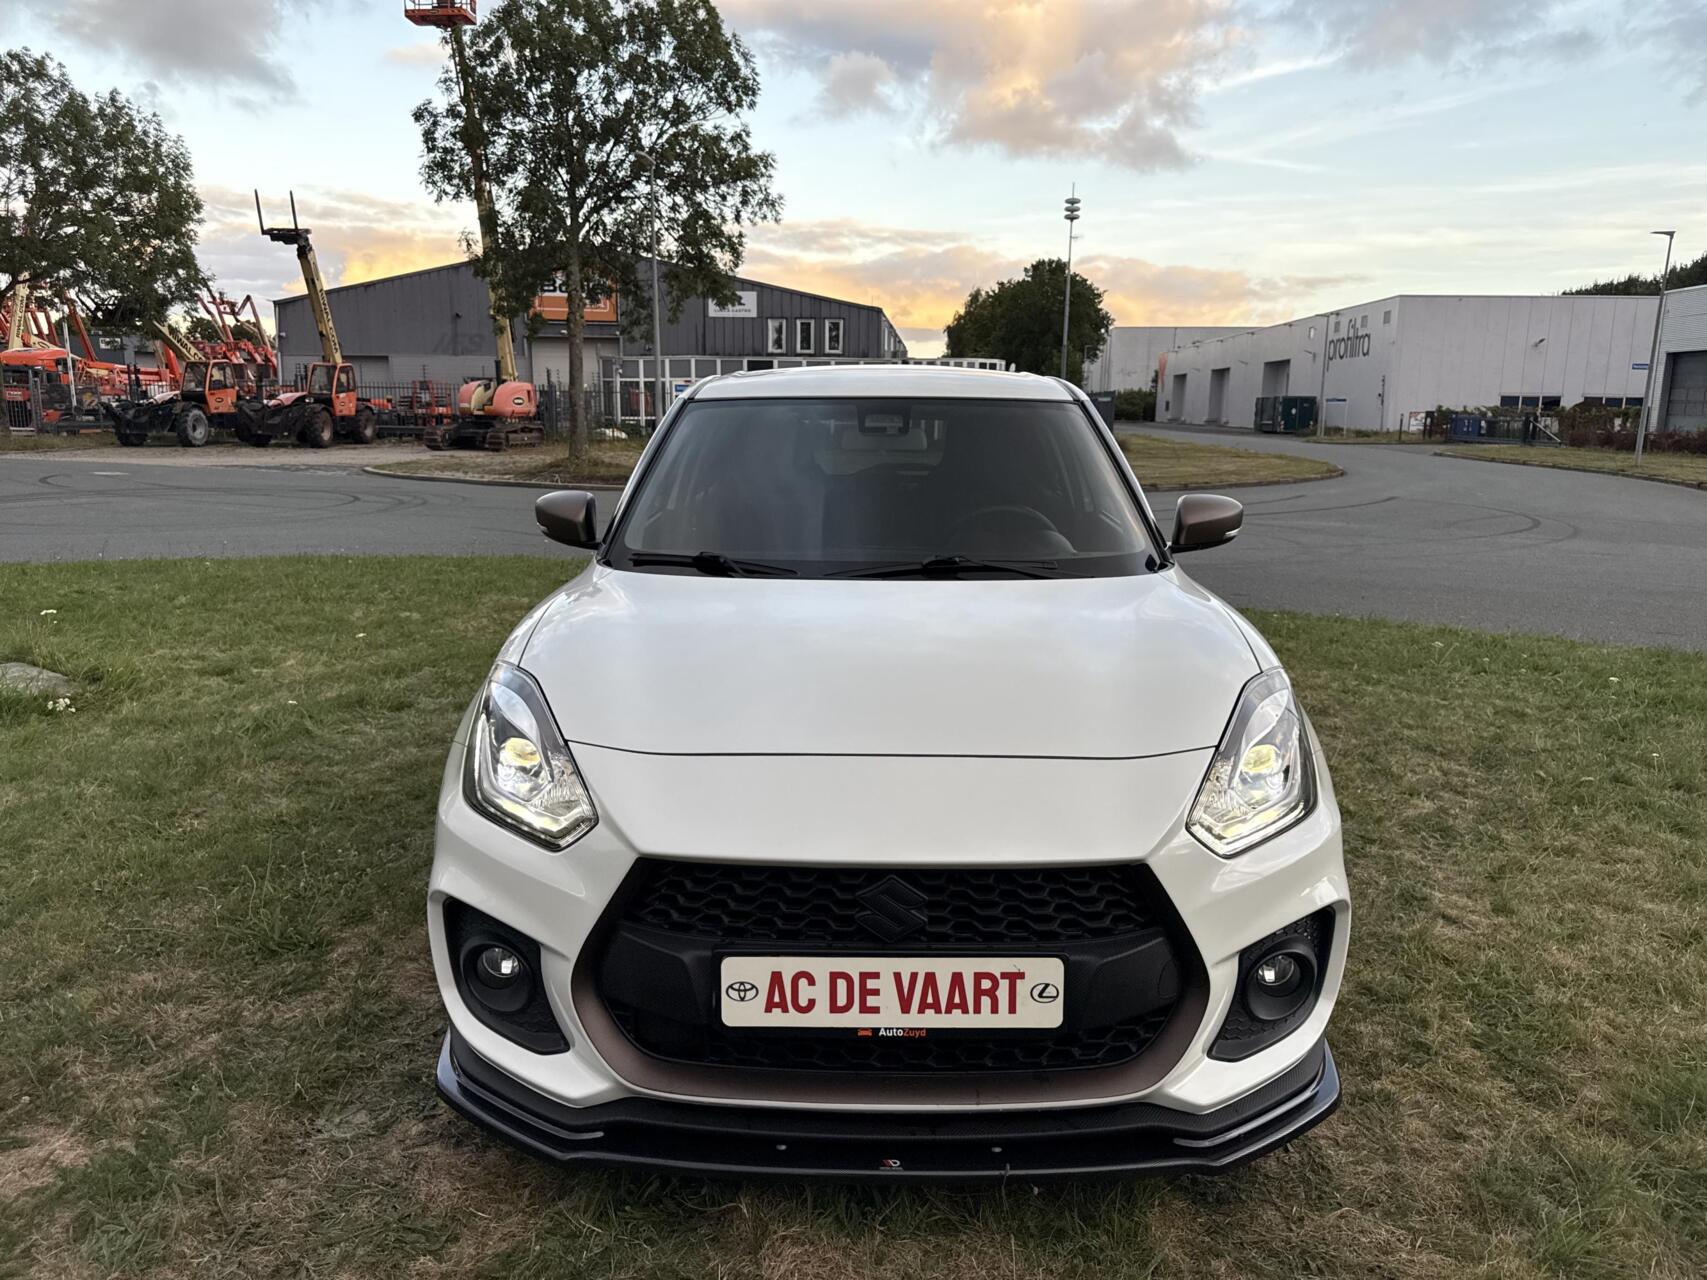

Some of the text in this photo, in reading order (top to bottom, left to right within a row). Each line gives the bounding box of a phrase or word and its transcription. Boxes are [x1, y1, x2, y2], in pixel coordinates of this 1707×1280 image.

[1326, 317, 1371, 372] profiltra
[764, 970, 1026, 1015] AC DE VAART
[878, 1027, 926, 1038] AutoZuyd
